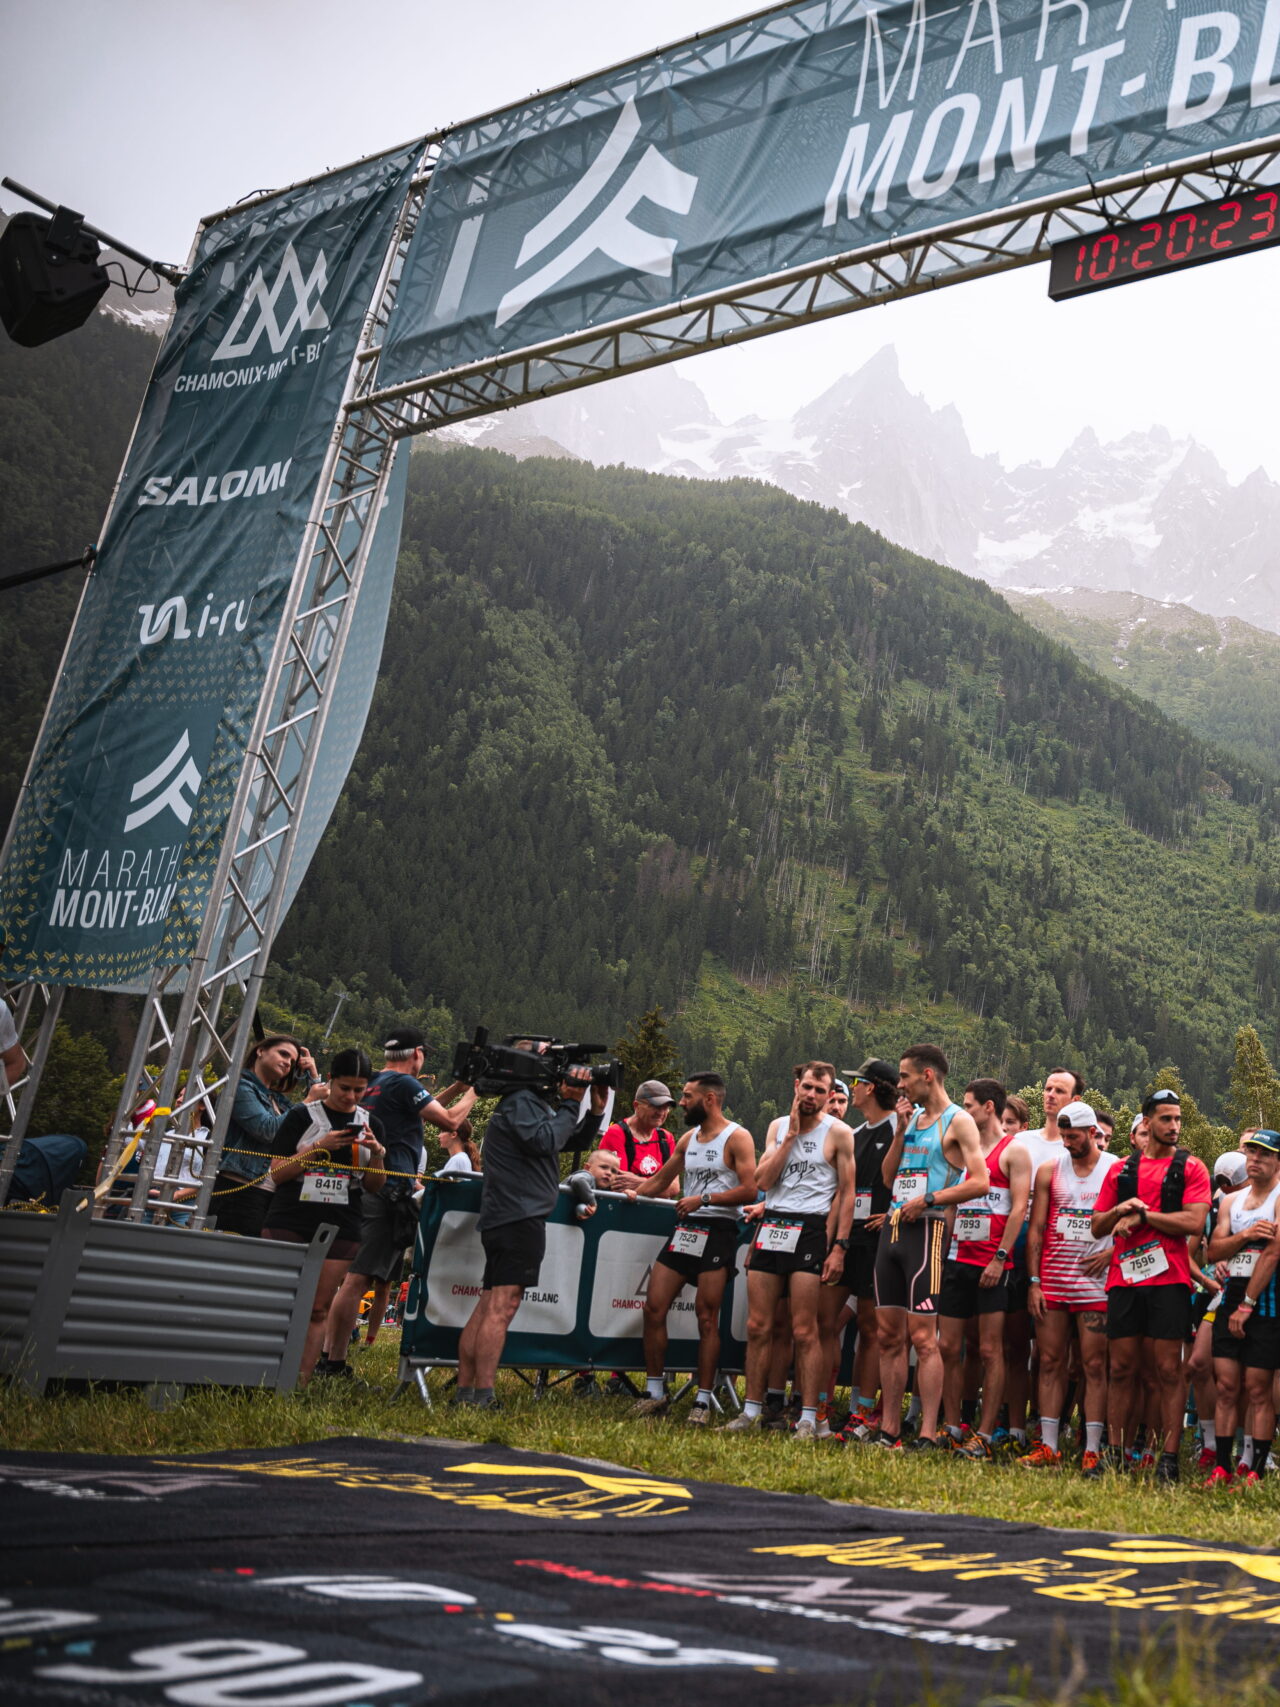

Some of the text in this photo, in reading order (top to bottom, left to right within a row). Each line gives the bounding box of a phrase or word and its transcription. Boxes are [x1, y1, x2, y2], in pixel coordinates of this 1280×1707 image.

[853, 0, 1176, 118] MAR
[1073, 191, 1279, 283] 10:20:23
[315, 1178, 343, 1191] 8415
[898, 1179, 917, 1189] 7503
[959, 1219, 981, 1229] 7893
[1066, 1219, 1091, 1230] 7529
[679, 1232, 698, 1244] 7523
[768, 1229, 790, 1240] 7515
[1130, 1253, 1156, 1271] 7596
